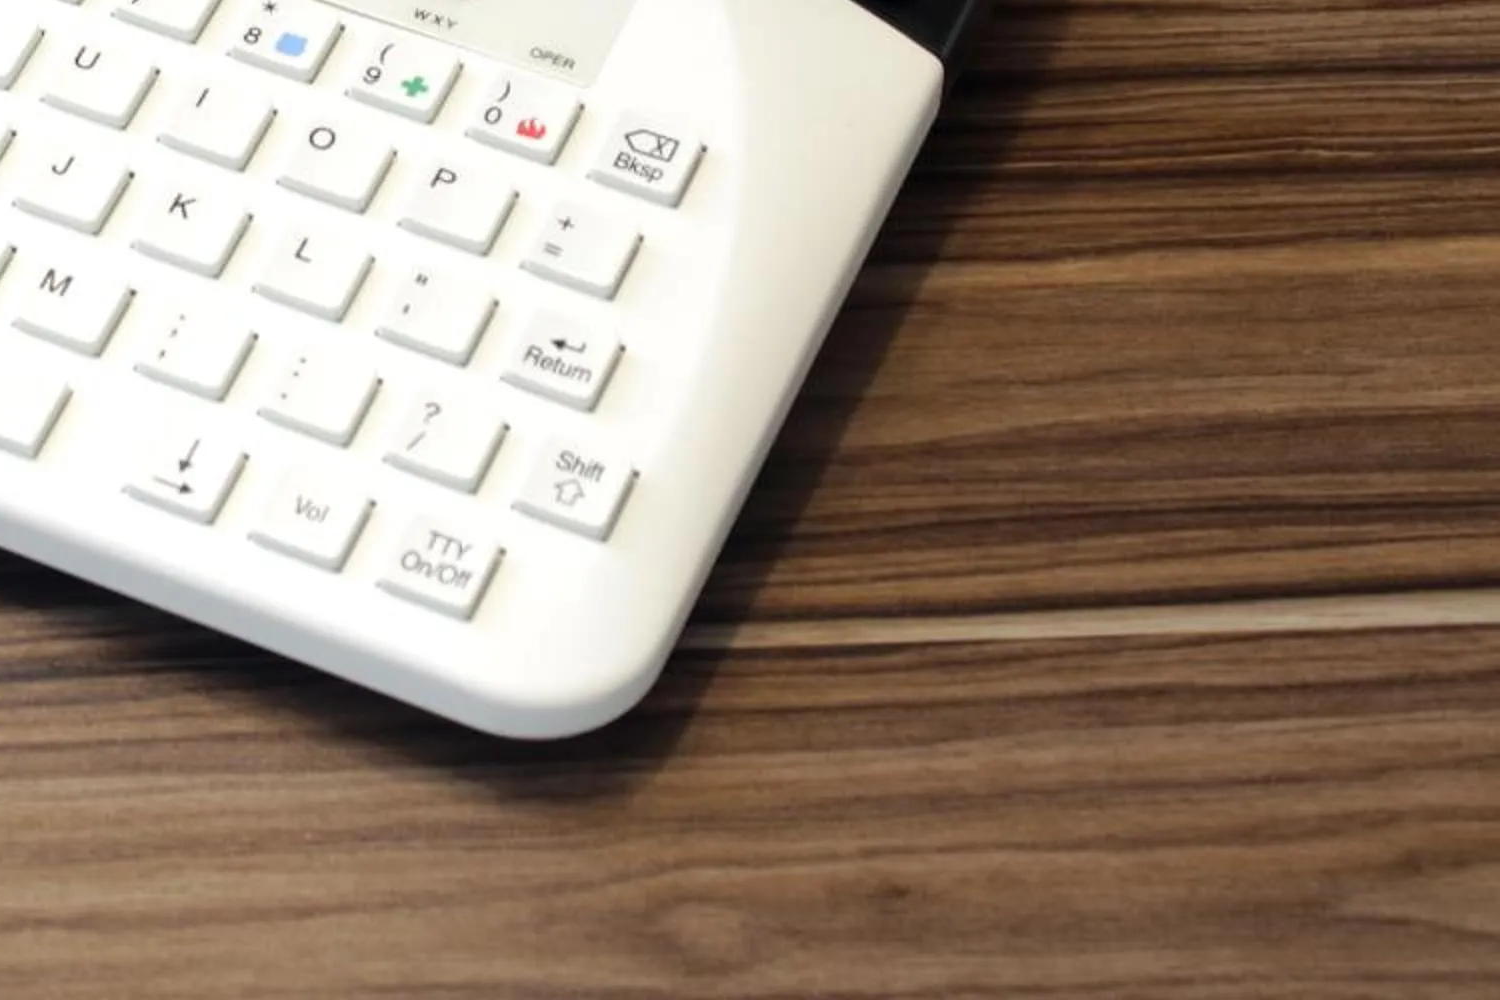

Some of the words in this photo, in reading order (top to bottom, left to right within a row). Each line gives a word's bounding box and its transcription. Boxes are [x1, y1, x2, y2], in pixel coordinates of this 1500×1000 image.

[413, 7, 459, 30] WXY
[243, 26, 263, 45] 8
[74, 46, 101, 70] U
[529, 46, 577, 71] OPER
[362, 66, 382, 85] 9
[195, 87, 210, 108] I
[483, 105, 503, 125] 0
[308, 127, 337, 151] O
[51, 156, 75, 176] J
[430, 167, 457, 188] P
[612, 150, 664, 184] Bksp
[169, 193, 197, 219] K
[293, 236, 313, 264] L
[39, 268, 74, 297] M
[523, 344, 593, 384] Return
[555, 450, 606, 483] Shift
[295, 495, 330, 523] Vol
[428, 529, 474, 561] TTY
[400, 549, 474, 590] On/Off
